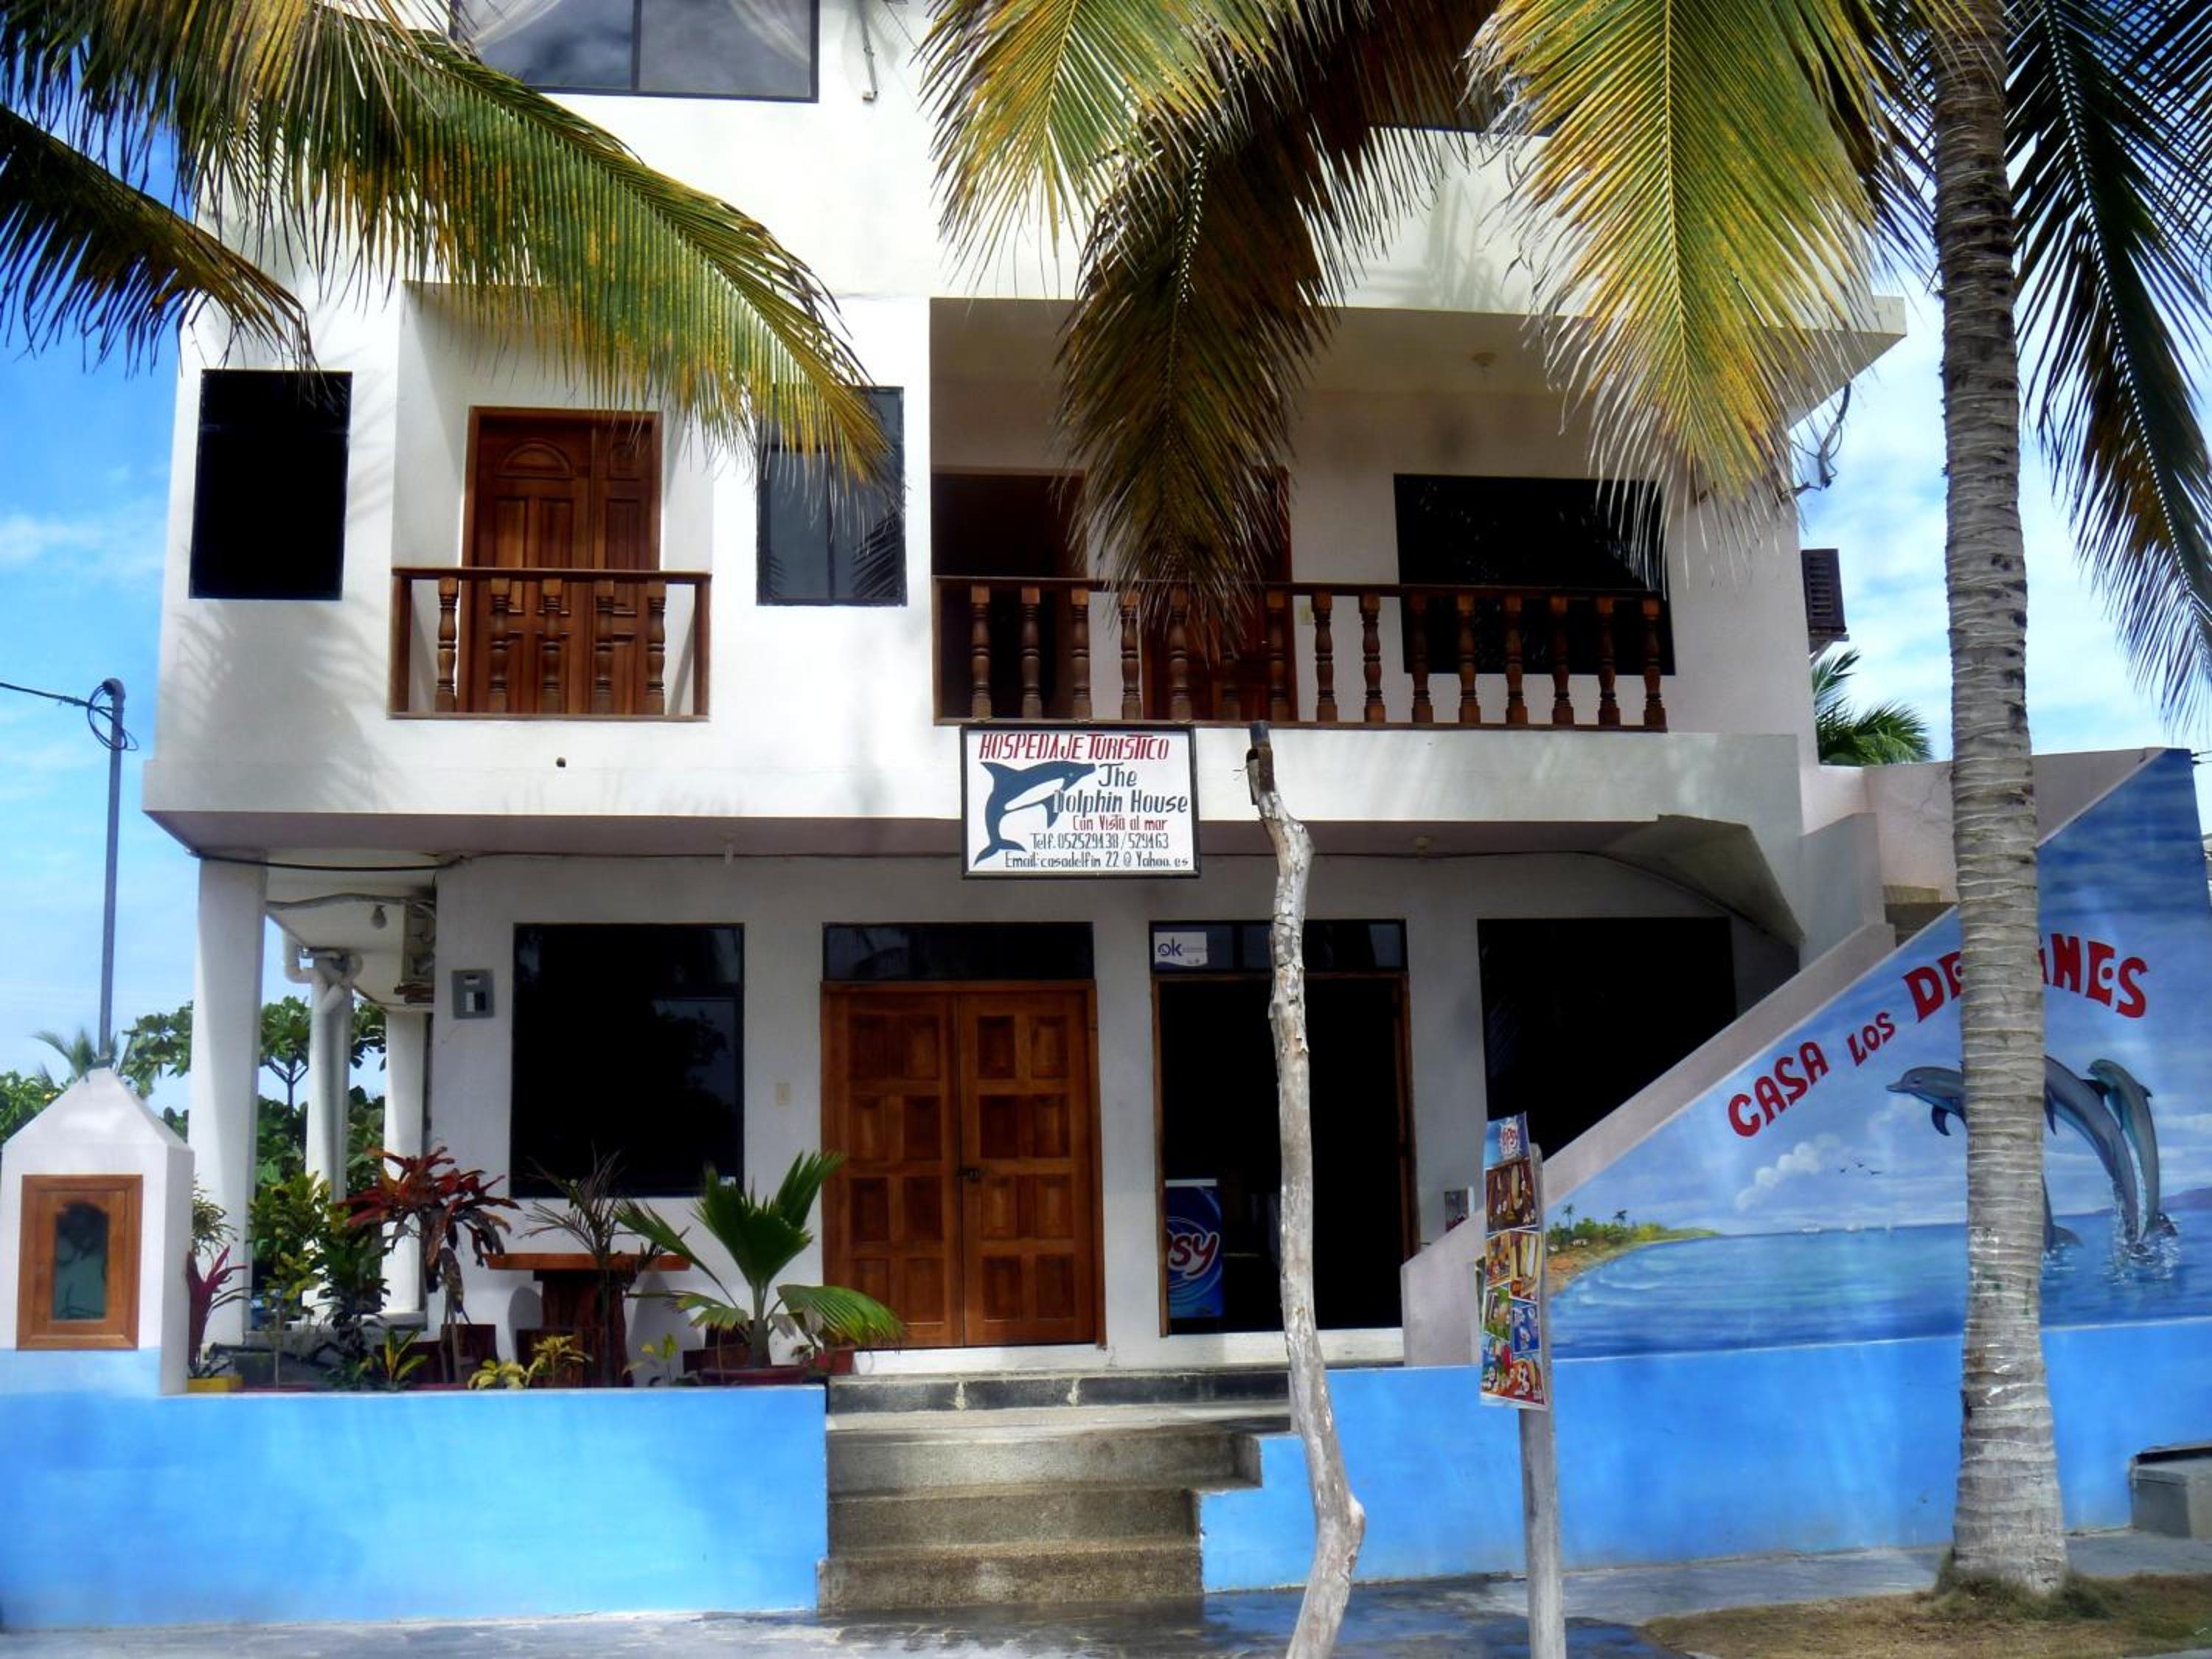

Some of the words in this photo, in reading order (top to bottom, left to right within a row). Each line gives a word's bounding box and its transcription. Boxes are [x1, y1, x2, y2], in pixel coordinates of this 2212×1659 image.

[978, 734, 1085, 760] HOSPEDAJE
[1086, 734, 1169, 760] TURISTICO
[1098, 762, 1137, 787] The
[1054, 790, 1122, 817] Dolphin
[1130, 790, 1188, 813] House
[1130, 815, 1139, 830] al
[1144, 819, 1168, 830] mar
[1728, 1041, 1829, 1136] CASA
[1846, 1012, 1896, 1066] LOS
